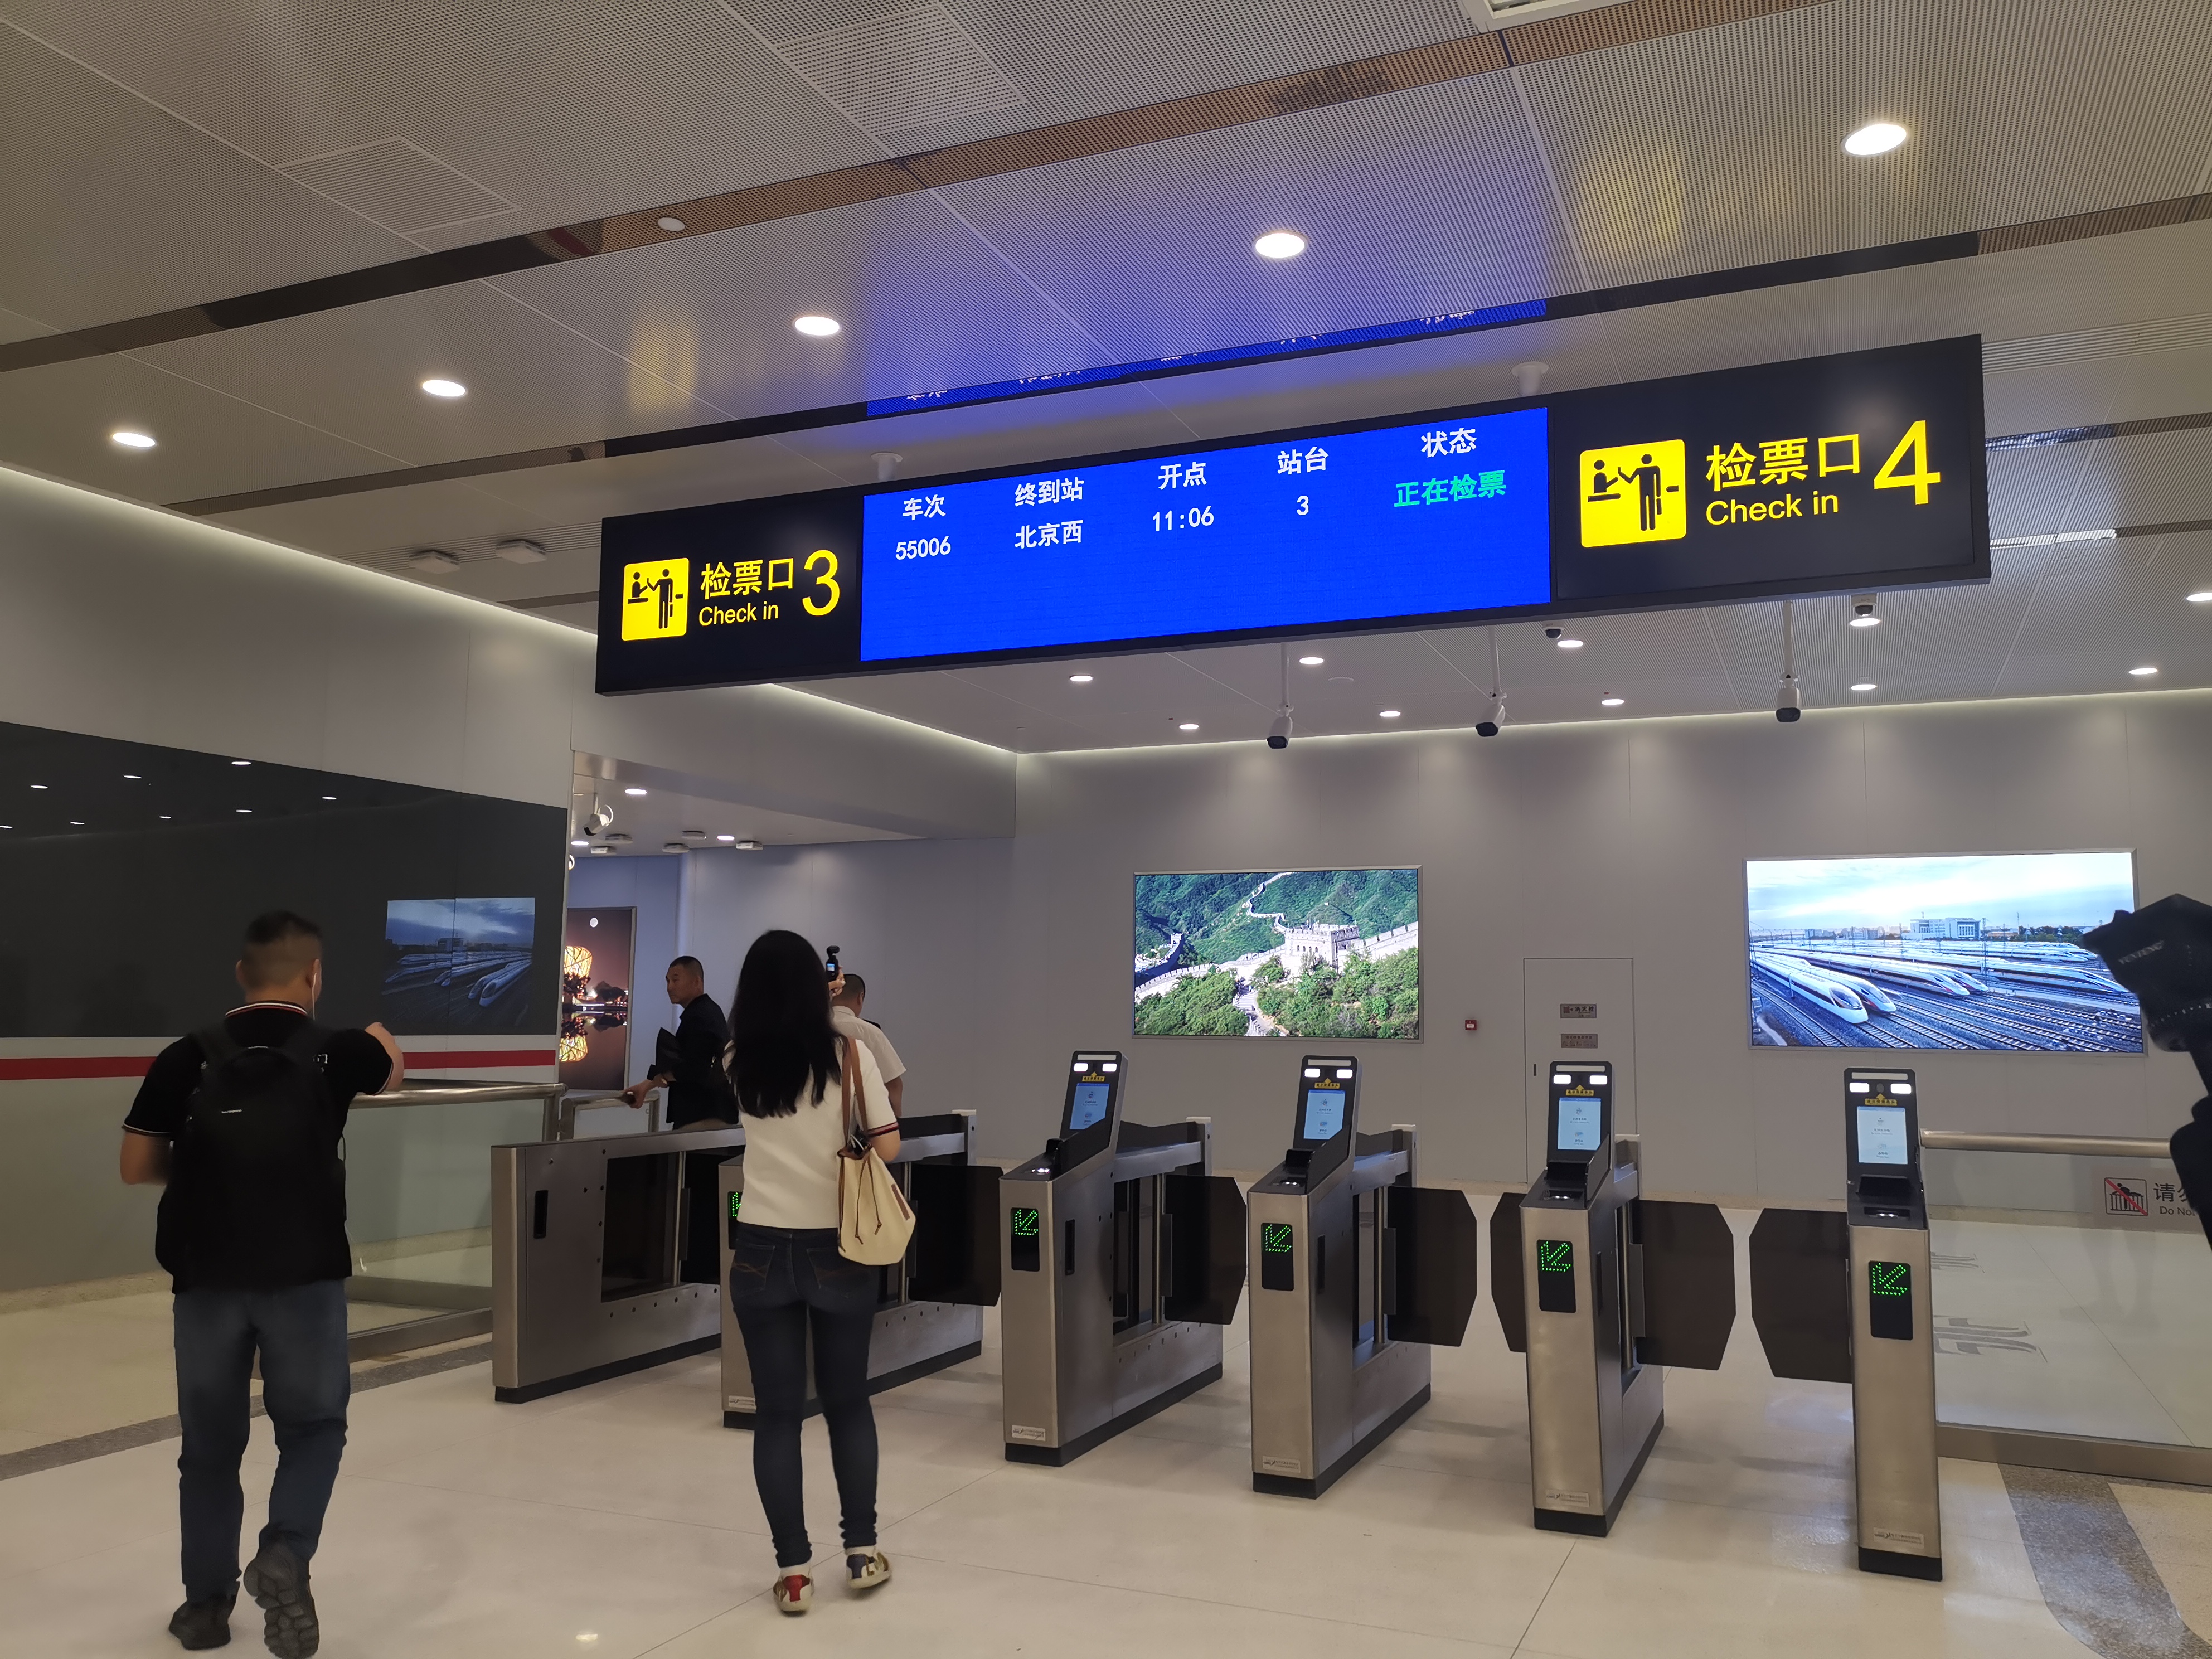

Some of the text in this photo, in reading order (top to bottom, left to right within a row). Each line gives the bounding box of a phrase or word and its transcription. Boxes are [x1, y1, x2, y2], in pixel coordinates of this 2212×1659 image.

[903, 428, 1477, 520] 车次 终到站 开点 站台 状态
[1706, 420, 1941, 505] 检票口 4
[895, 469, 1507, 560] 55006 北京西 11:06 3 正在检票
[1706, 491, 1839, 525] Check in
[699, 601, 779, 626] Check in
[700, 550, 840, 616] 检票口 3
[2160, 1206, 2196, 1216] Do No
